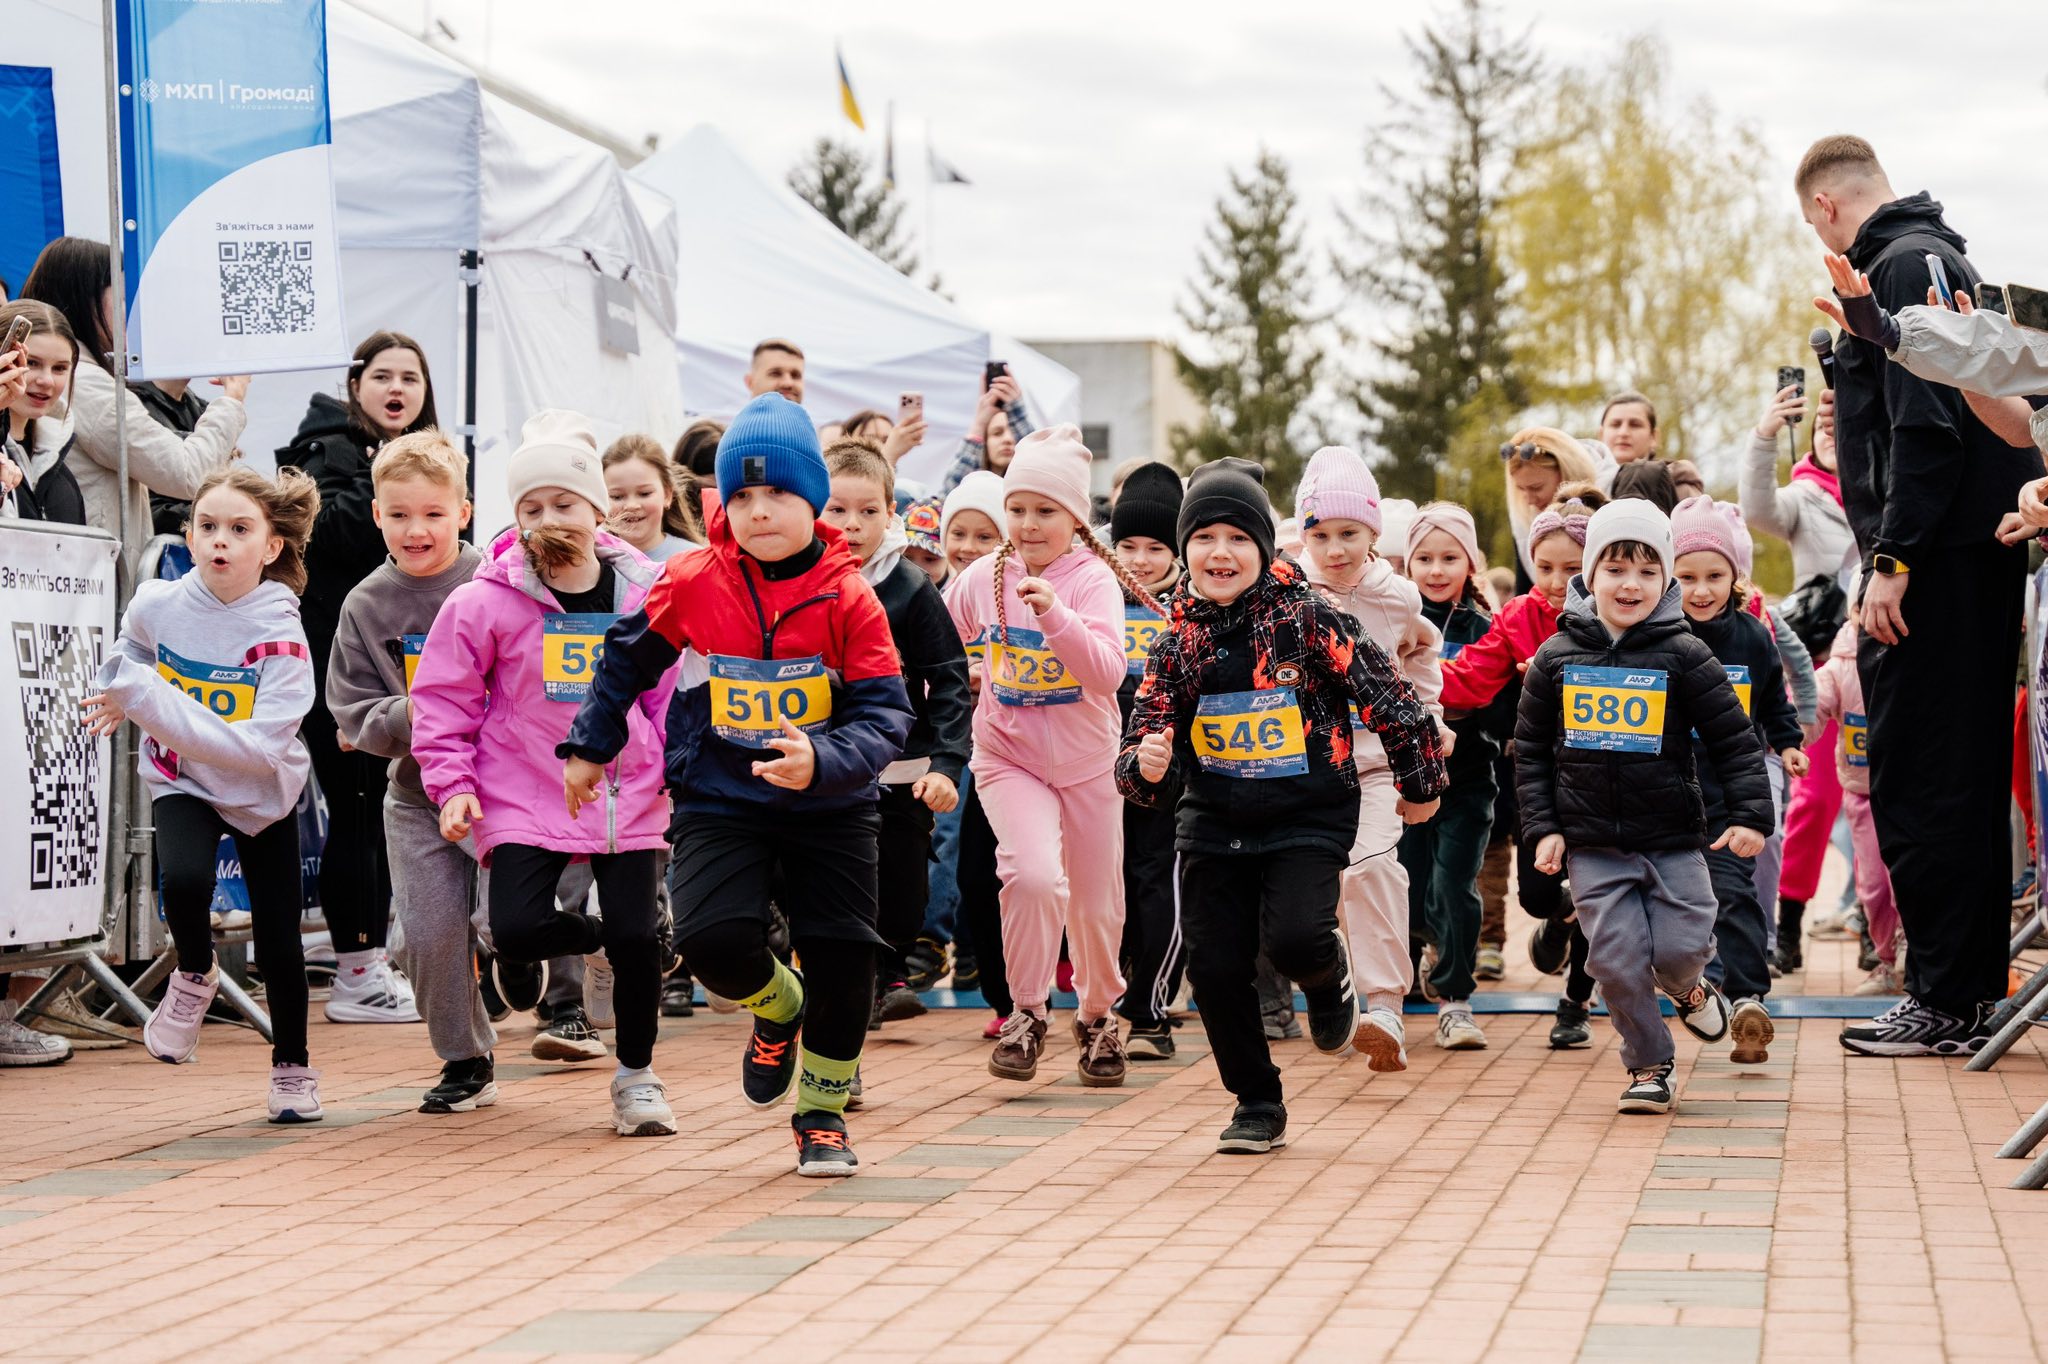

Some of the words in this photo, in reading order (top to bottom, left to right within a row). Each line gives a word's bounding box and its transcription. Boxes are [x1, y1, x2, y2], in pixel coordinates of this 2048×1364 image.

[165, 83, 213, 99] МХП
[230, 84, 315, 103] Громаді
[216, 222, 274, 231] Зв'яжіться
[277, 223, 283, 231] з
[286, 223, 314, 231] нами
[1, 566, 71, 594] Зв'яжіться
[213, 671, 239, 679] AMC
[782, 665, 808, 675] AMC
[1628, 676, 1651, 684] AMC
[726, 687, 808, 721] 510
[1256, 695, 1281, 706] AMC
[1573, 693, 1649, 727] 580
[1202, 717, 1285, 753] 546
